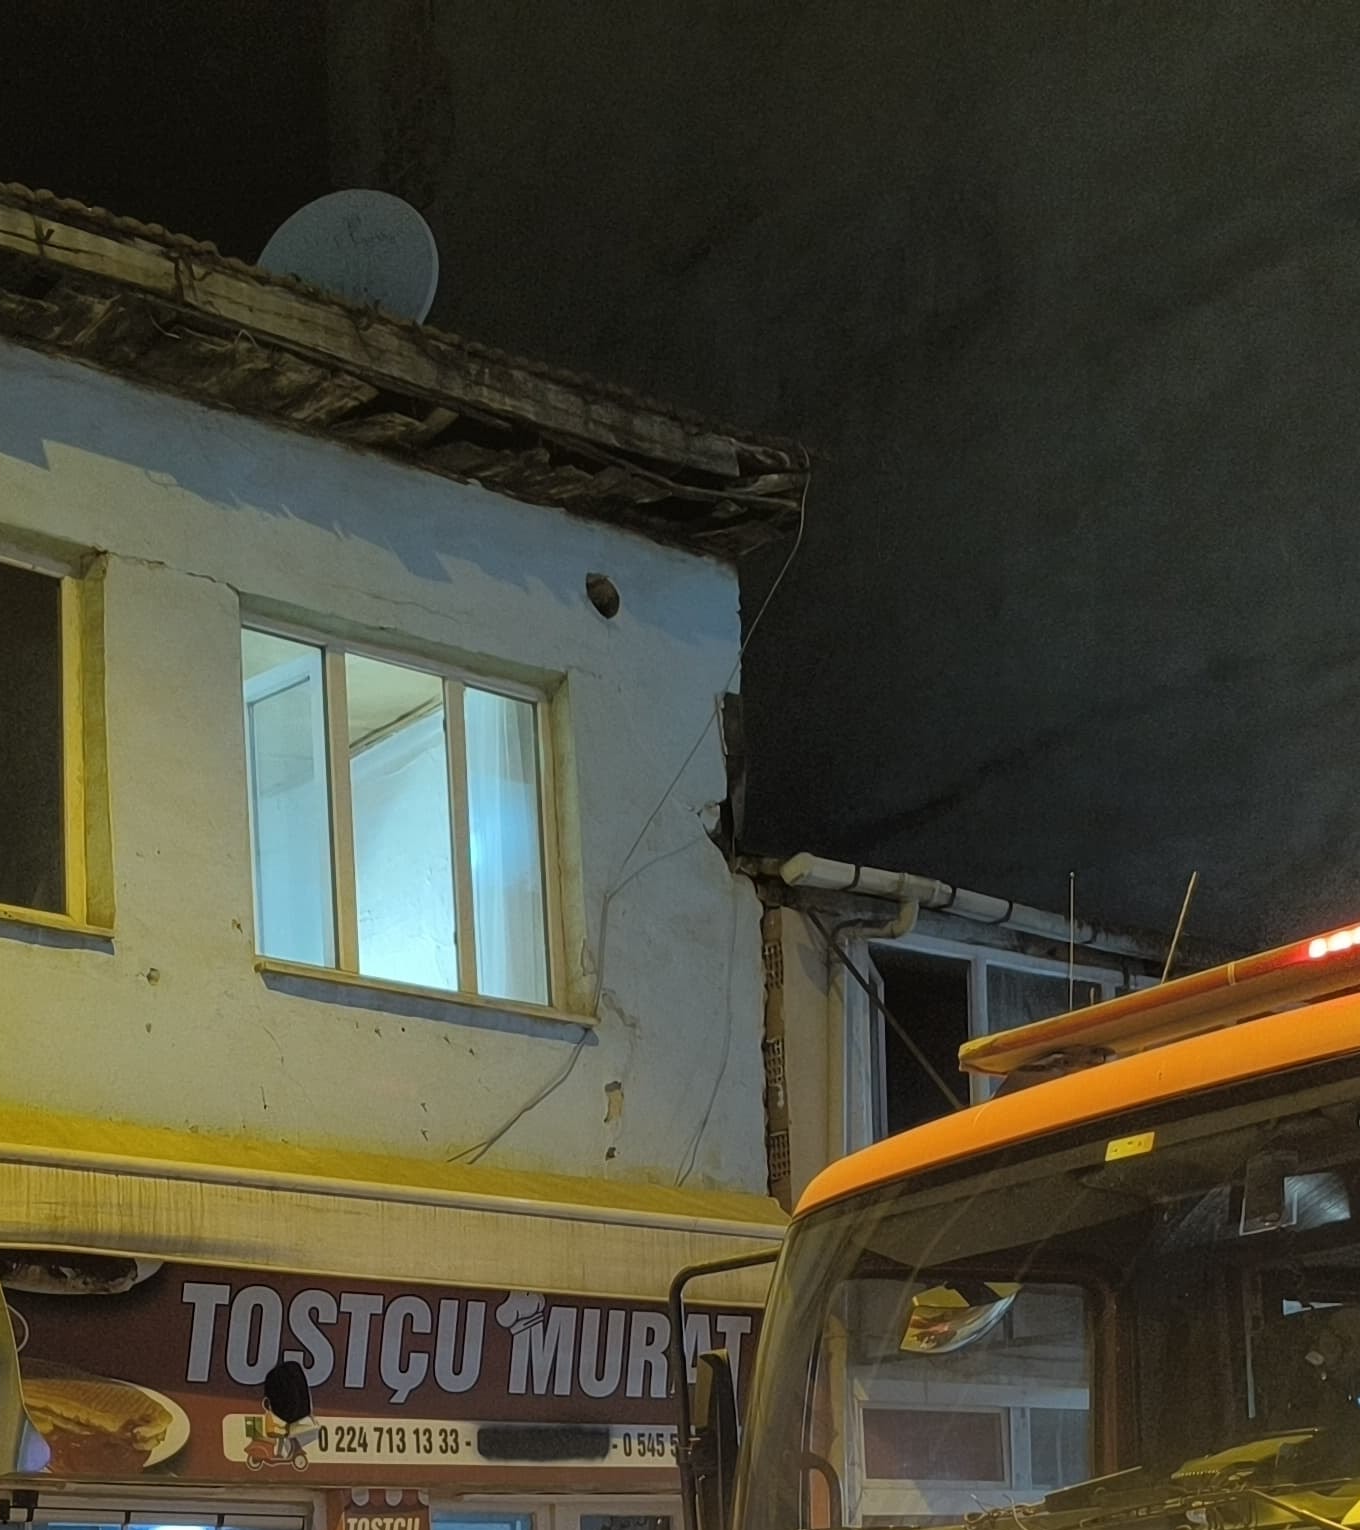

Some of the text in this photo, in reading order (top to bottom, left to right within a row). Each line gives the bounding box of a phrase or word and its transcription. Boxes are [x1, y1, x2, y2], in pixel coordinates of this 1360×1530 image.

[183, 1283, 486, 1403] TOSTÇU
[318, 1426, 328, 1452] 0
[335, 1426, 368, 1453] 224
[373, 1427, 407, 1454] 713
[413, 1427, 433, 1454] 13
[439, 1428, 460, 1455] 33
[638, 1433, 665, 1457] 545
